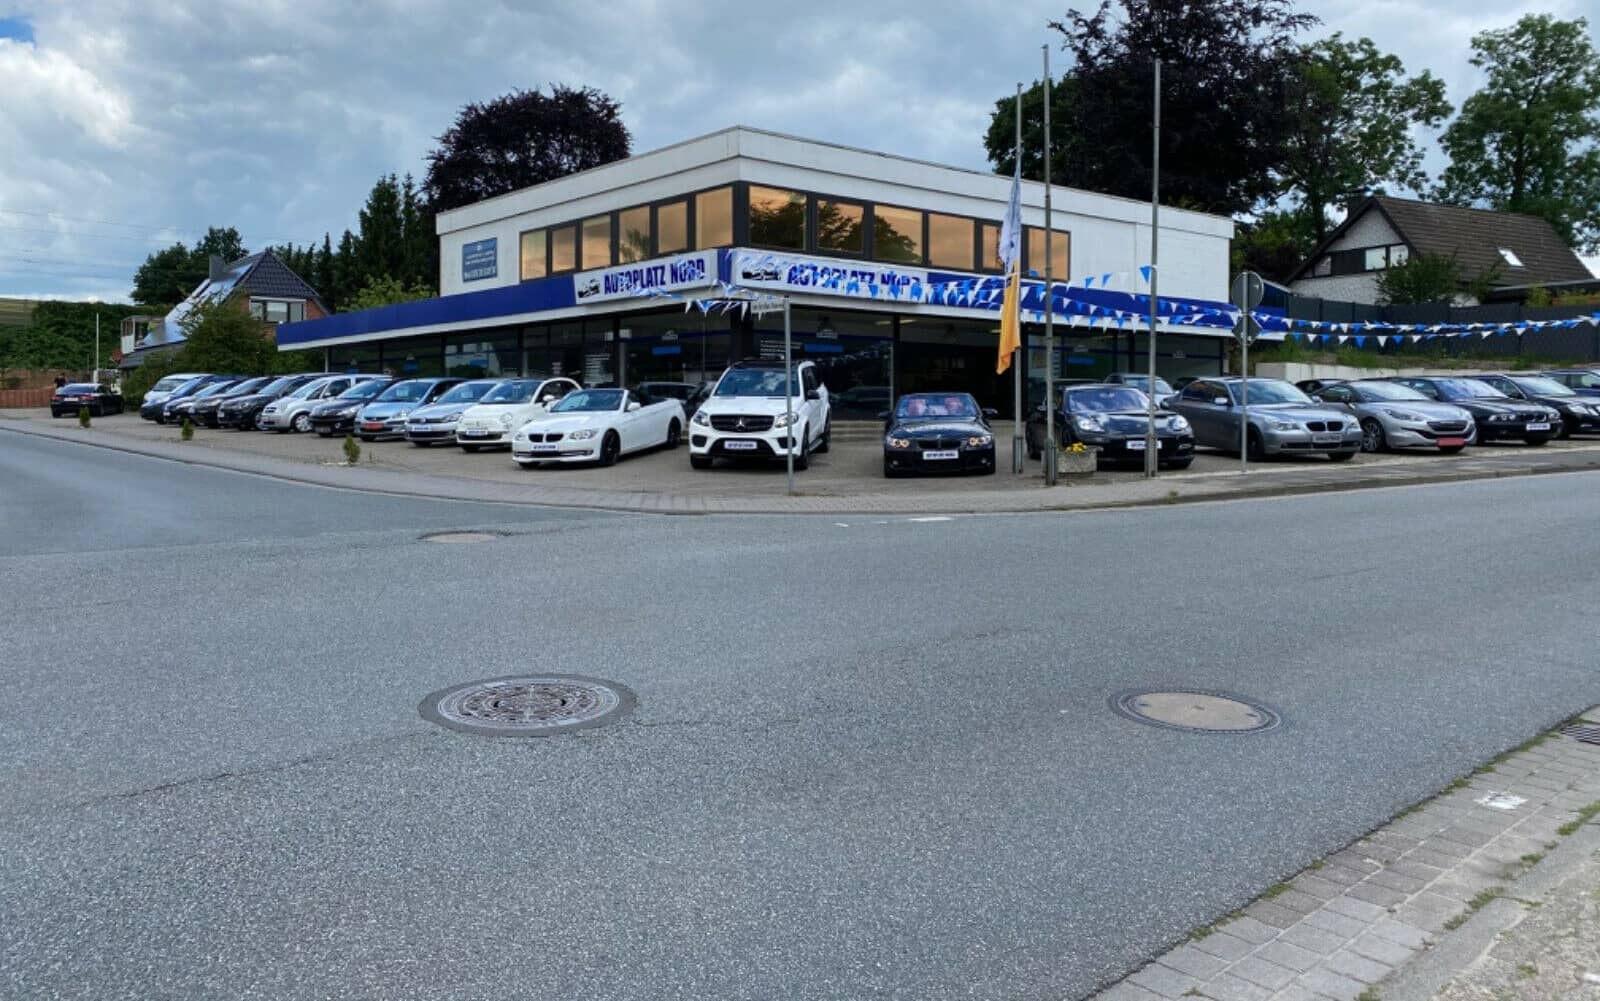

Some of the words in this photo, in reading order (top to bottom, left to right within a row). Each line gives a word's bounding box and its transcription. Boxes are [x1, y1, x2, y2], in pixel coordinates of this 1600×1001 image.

[604, 265, 666, 294] AUTOPLATZ
[670, 258, 705, 284] NORD
[880, 271, 921, 294] NOR
